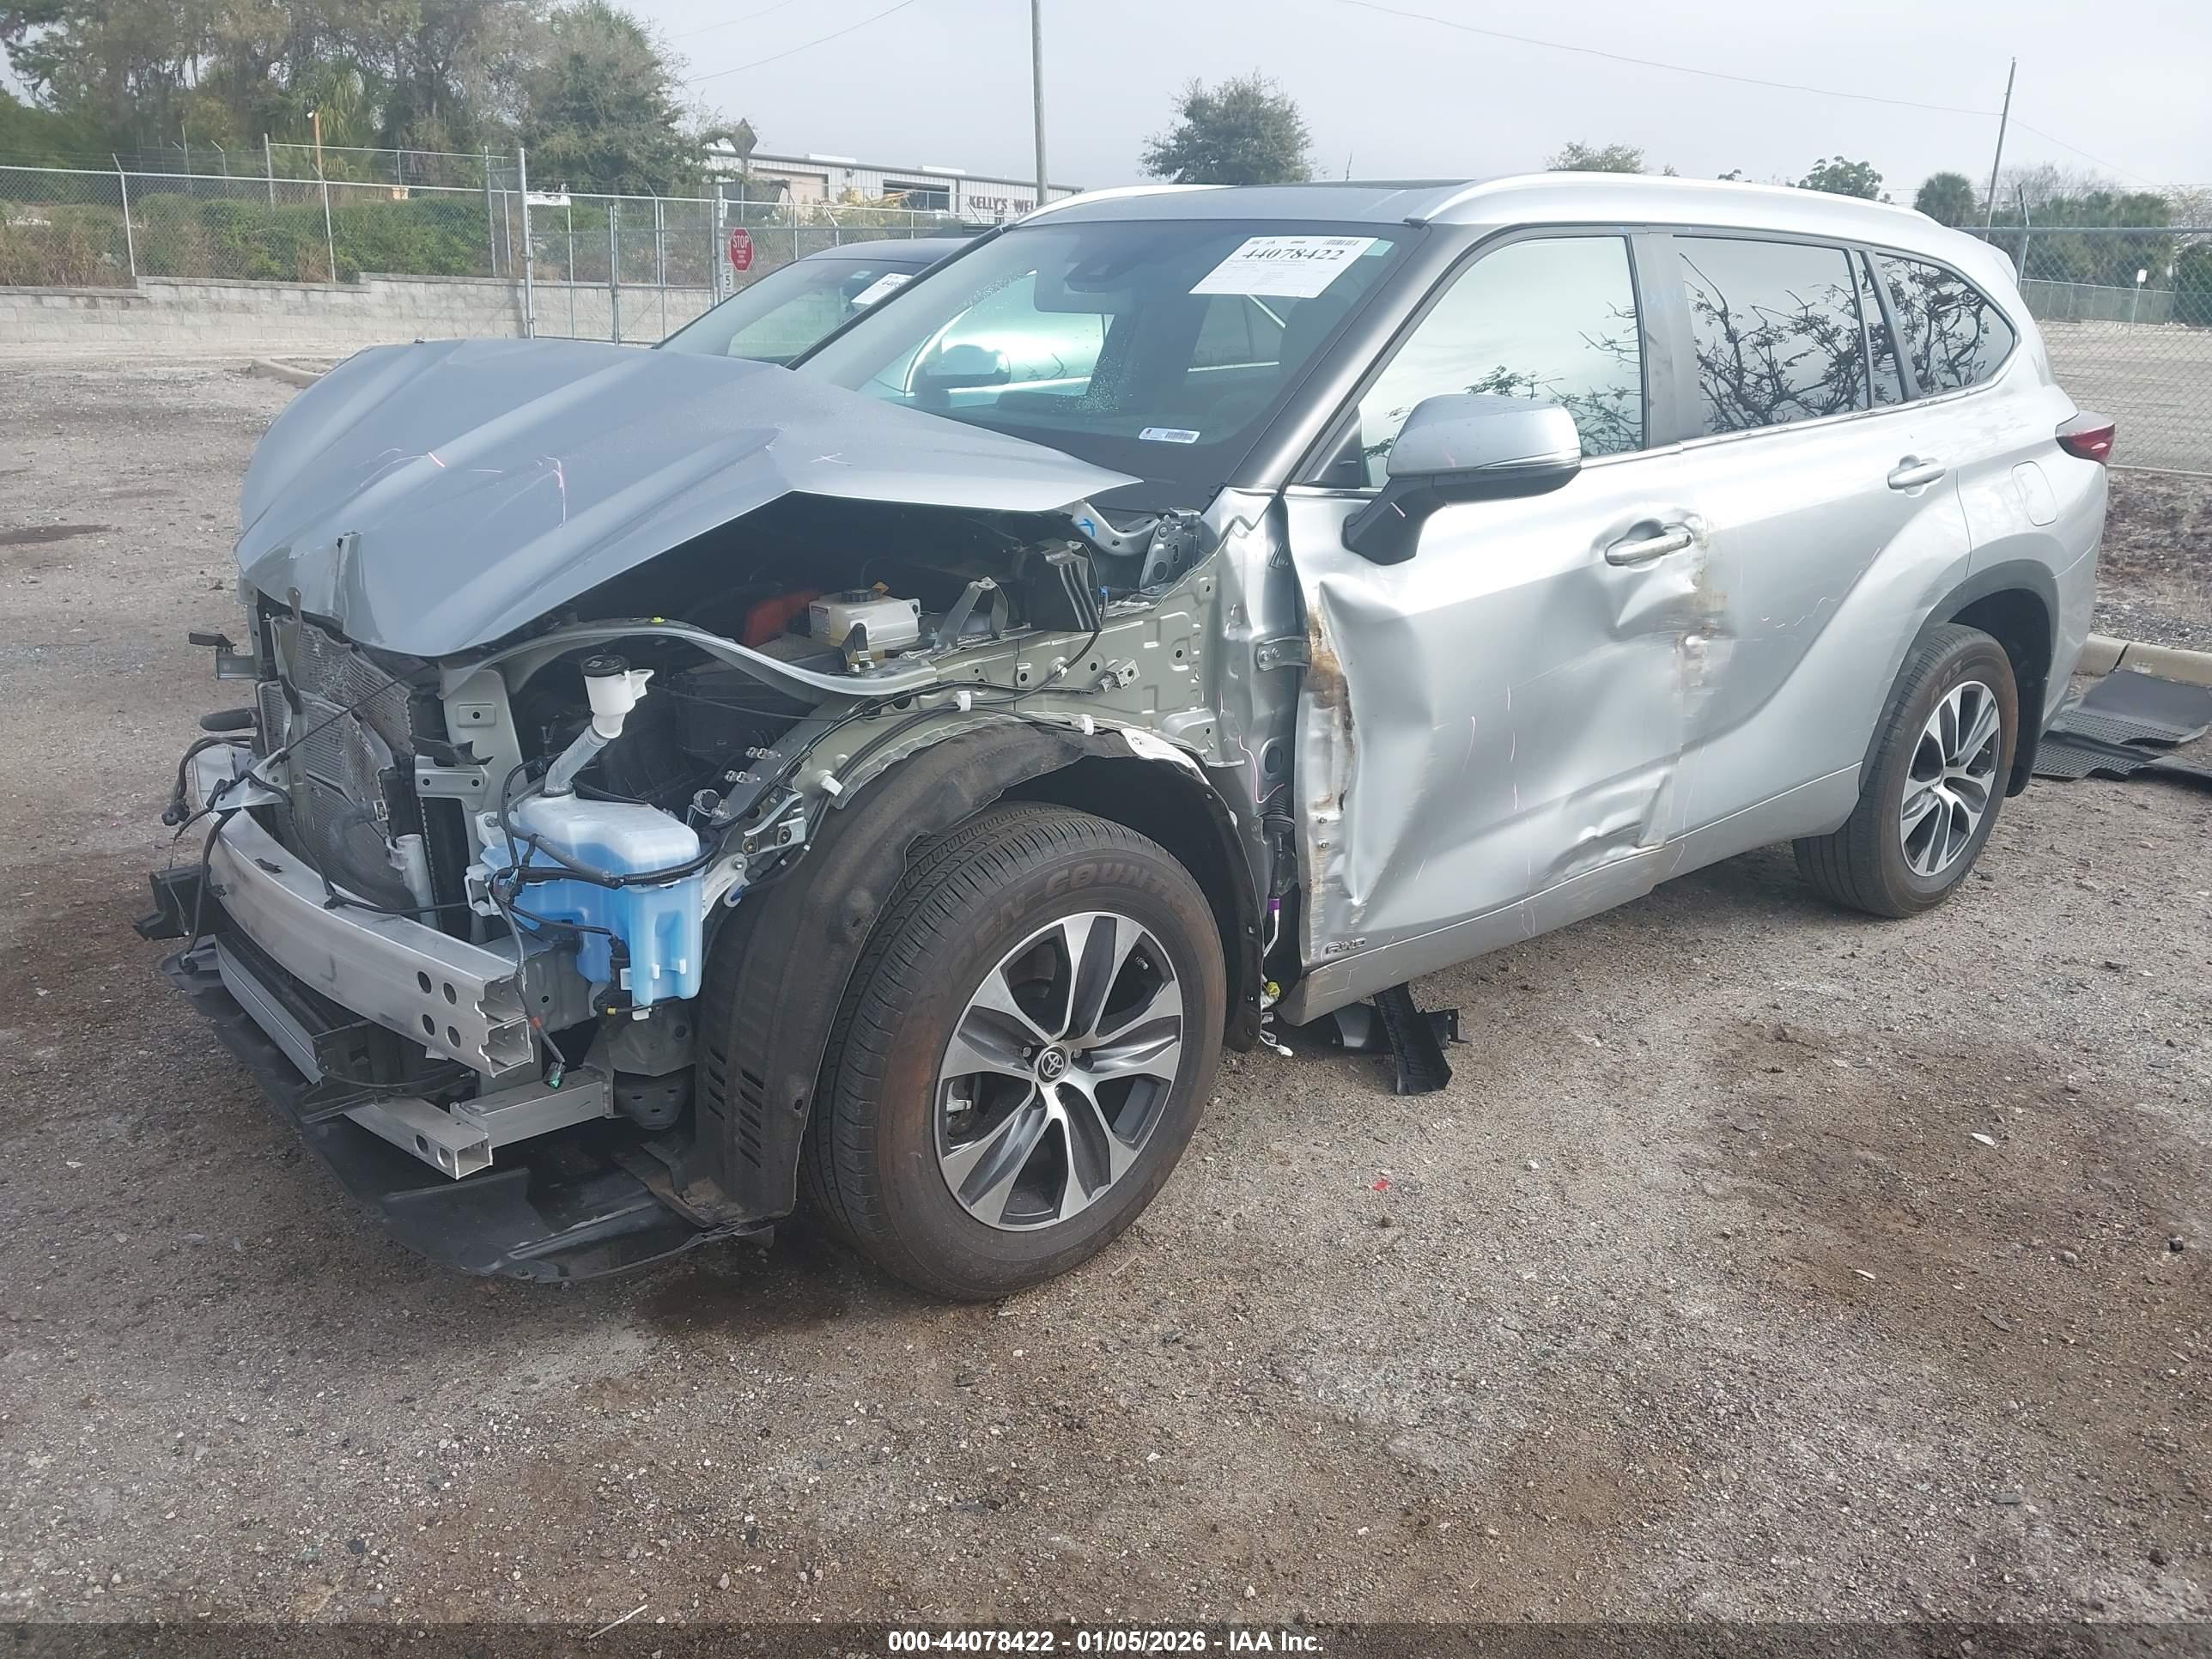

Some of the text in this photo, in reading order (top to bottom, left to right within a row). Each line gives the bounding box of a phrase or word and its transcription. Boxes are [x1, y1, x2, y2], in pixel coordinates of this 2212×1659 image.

[969, 195, 1008, 210] KELLY'S
[732, 234, 750, 248] STOP
[1243, 248, 1346, 260] 44078422
[725, 275, 731, 287] 5
